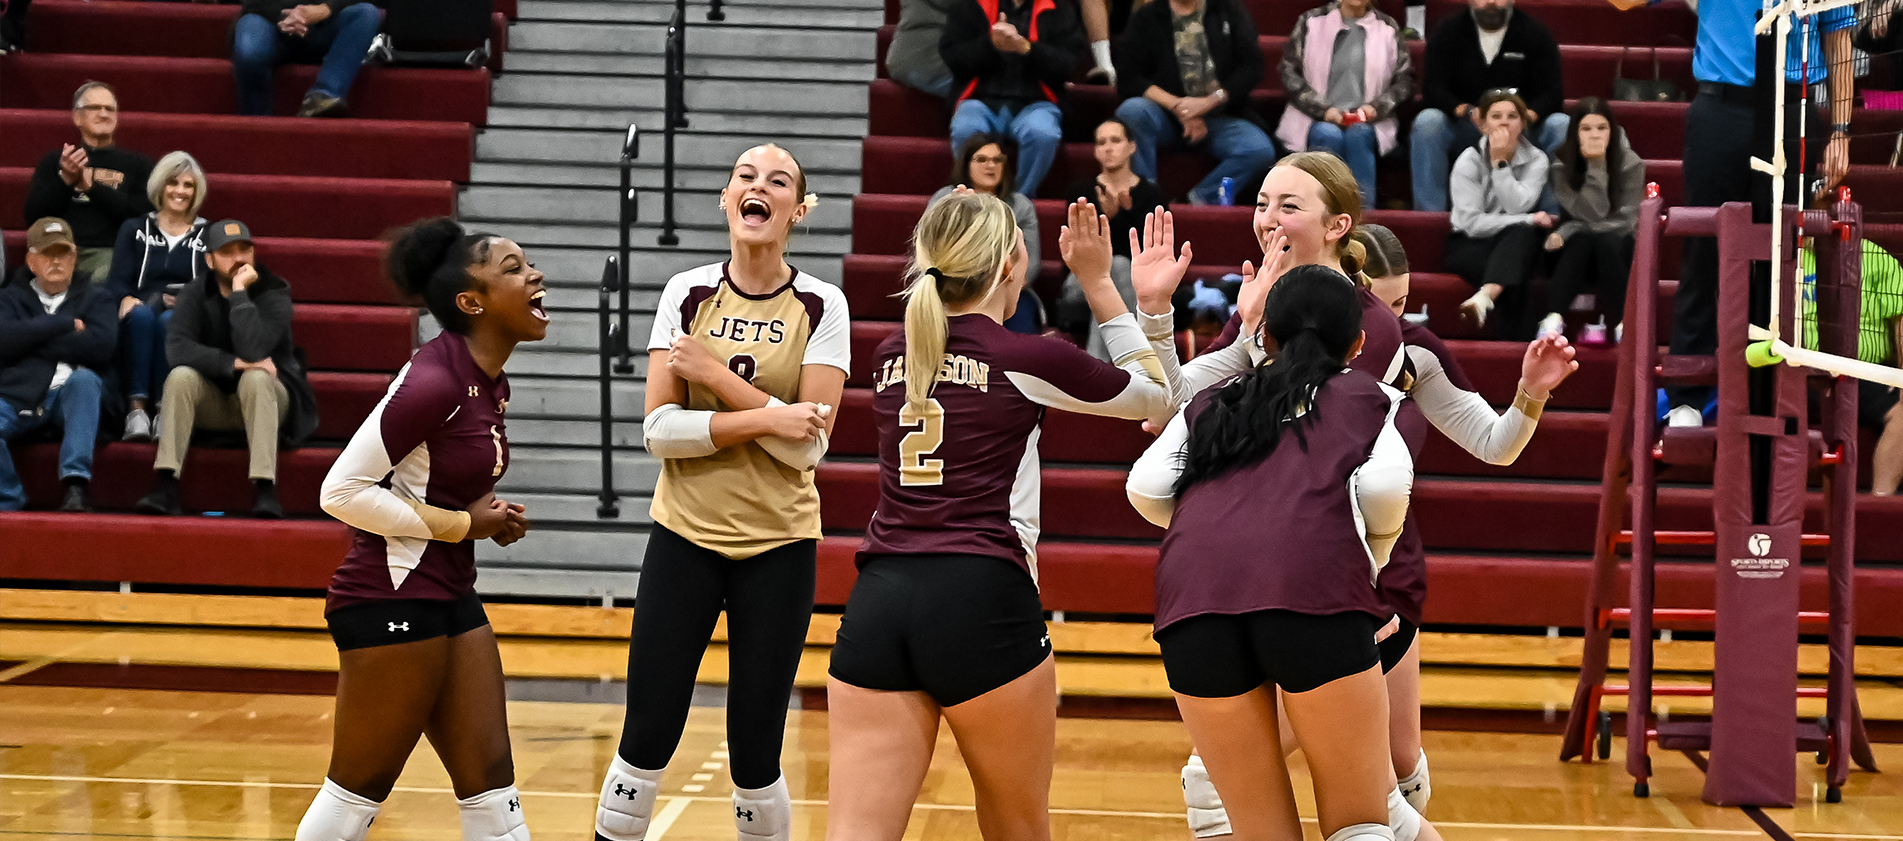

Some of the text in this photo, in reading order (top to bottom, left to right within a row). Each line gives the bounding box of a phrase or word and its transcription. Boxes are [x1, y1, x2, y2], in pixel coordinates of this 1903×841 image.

[709, 316, 785, 344] JETS
[876, 353, 990, 393] JASON
[489, 424, 504, 477] 1
[898, 397, 945, 487] 2
